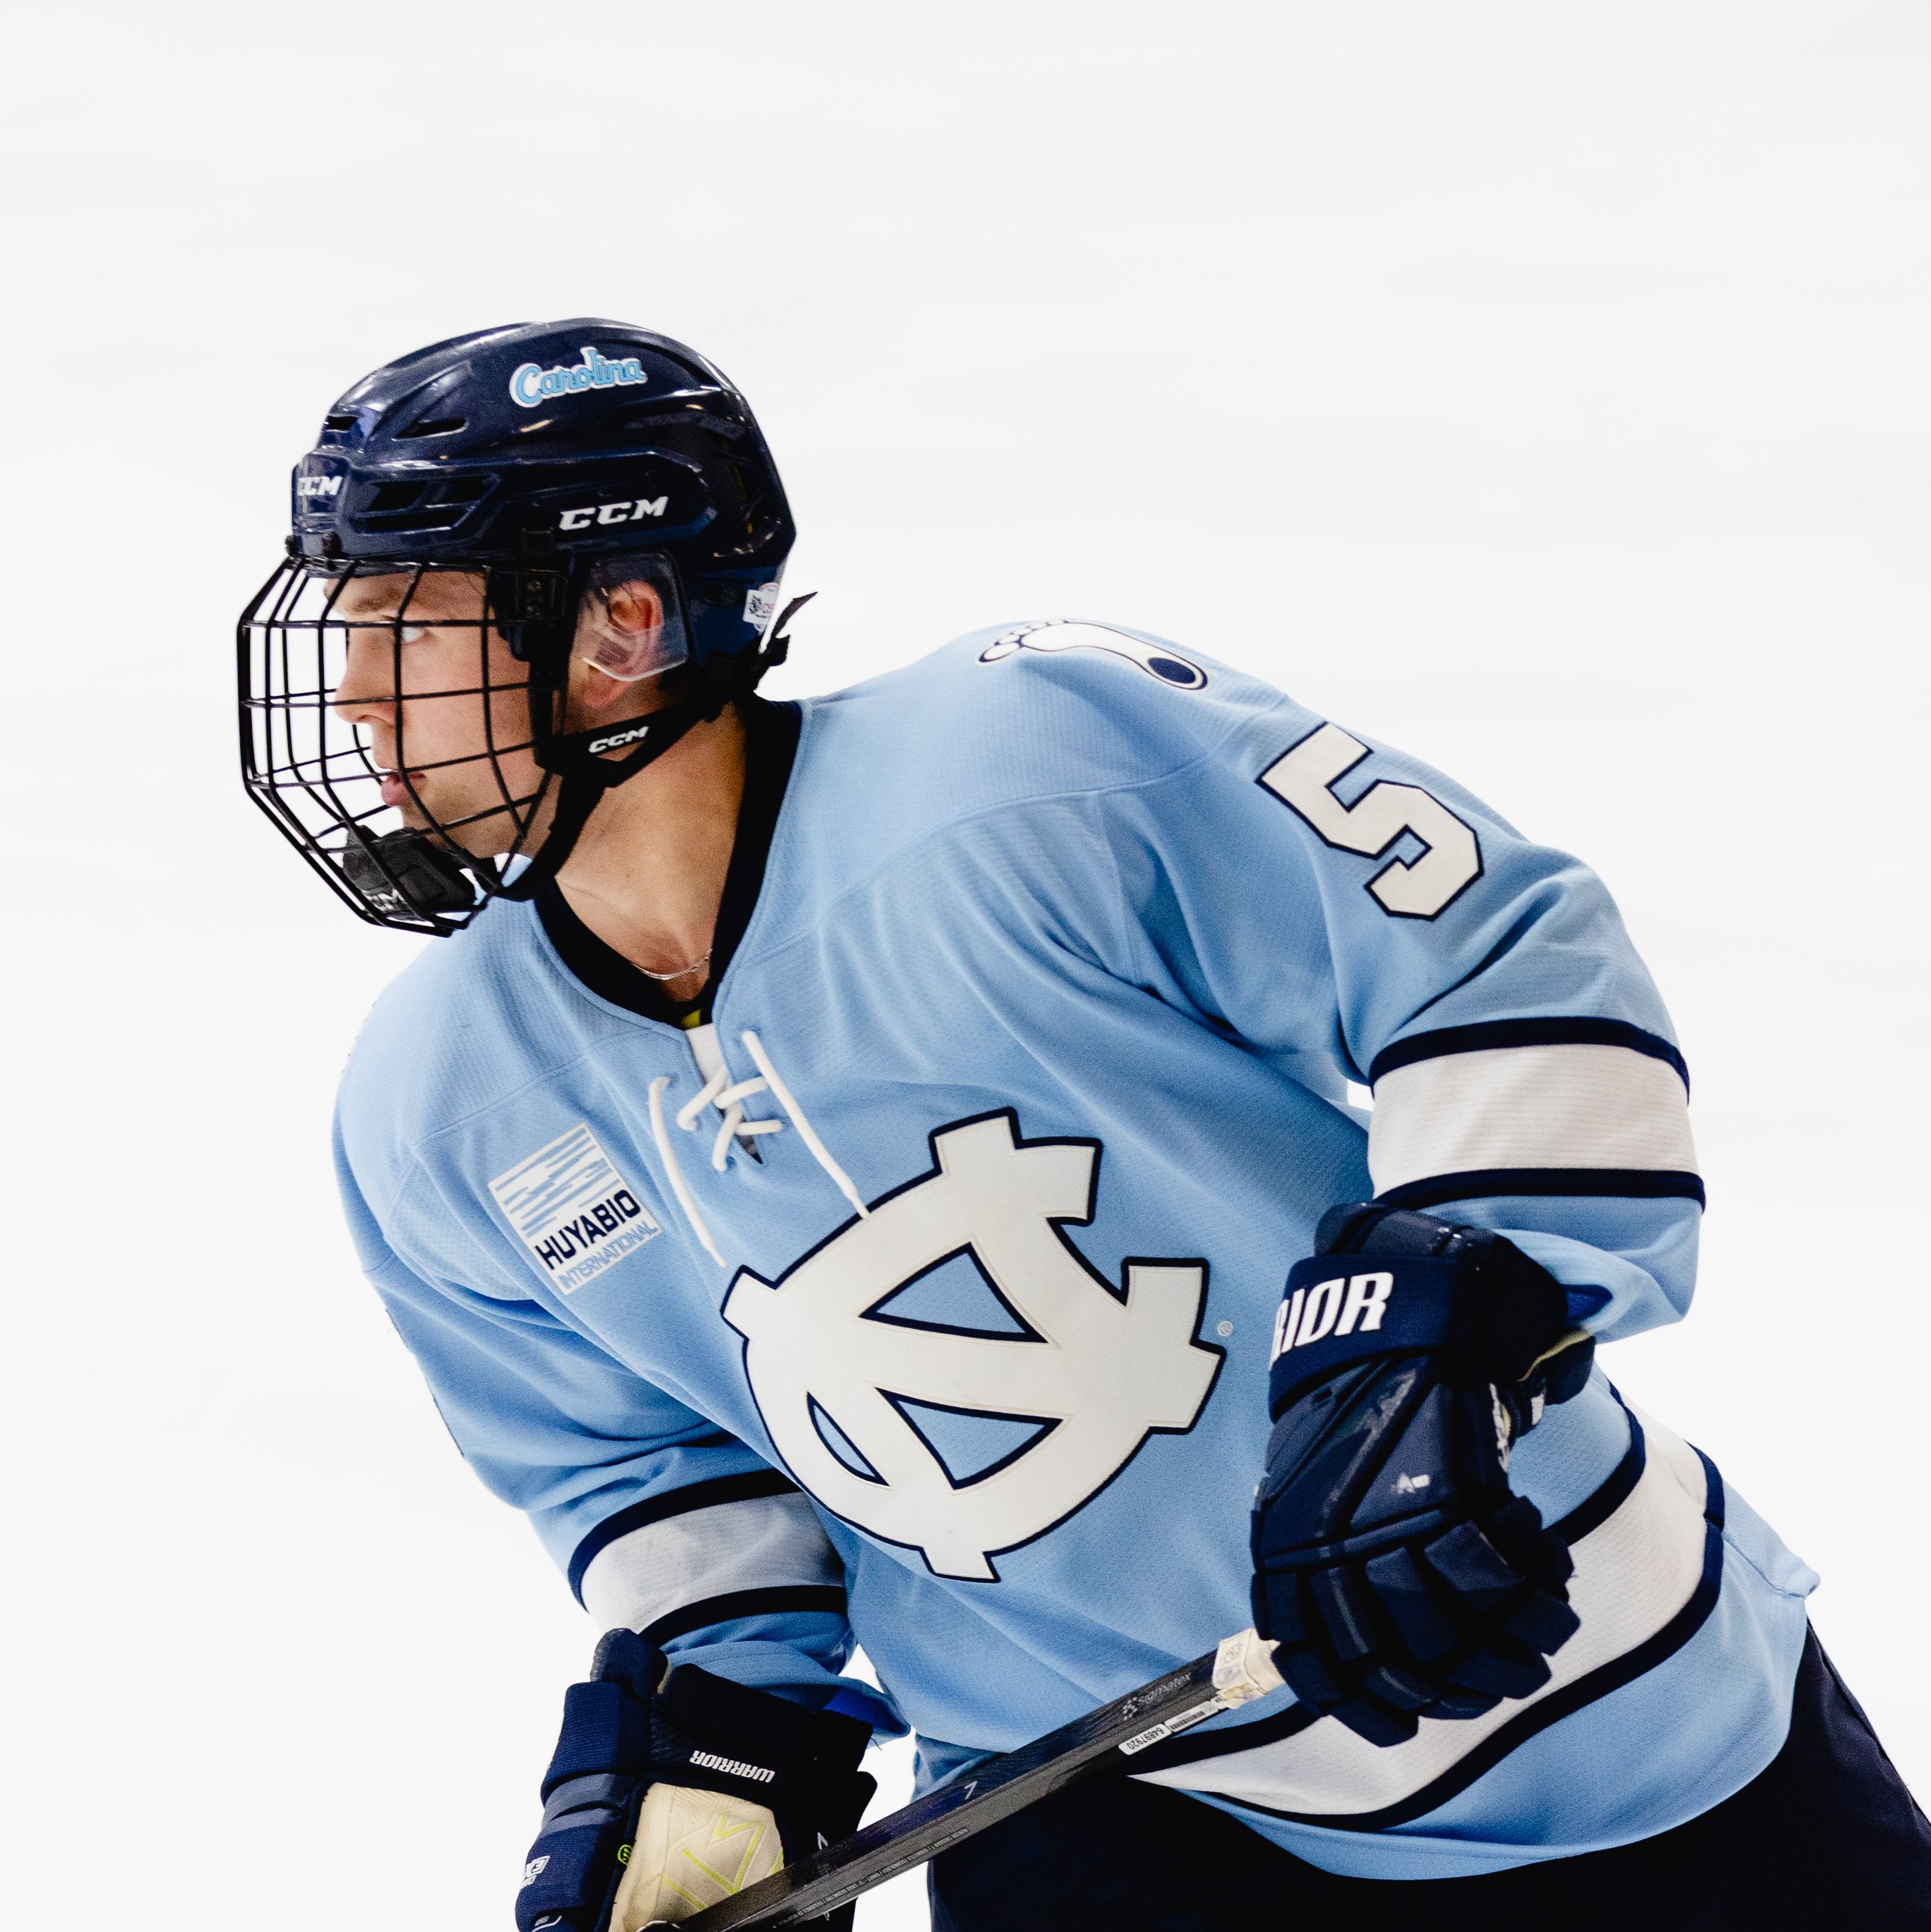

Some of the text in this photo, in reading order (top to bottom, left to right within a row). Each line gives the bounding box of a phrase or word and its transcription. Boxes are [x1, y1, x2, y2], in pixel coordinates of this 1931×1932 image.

[509, 346, 648, 408] Carolina
[297, 476, 343, 496] CCM
[559, 496, 669, 530] CCM
[588, 725, 649, 753] CCM
[1254, 721, 1485, 921] 5
[535, 1189, 640, 1270] HUYABIO
[558, 1220, 657, 1289] INTERNATIONAL
[689, 1750, 776, 1783] WARRIOR
